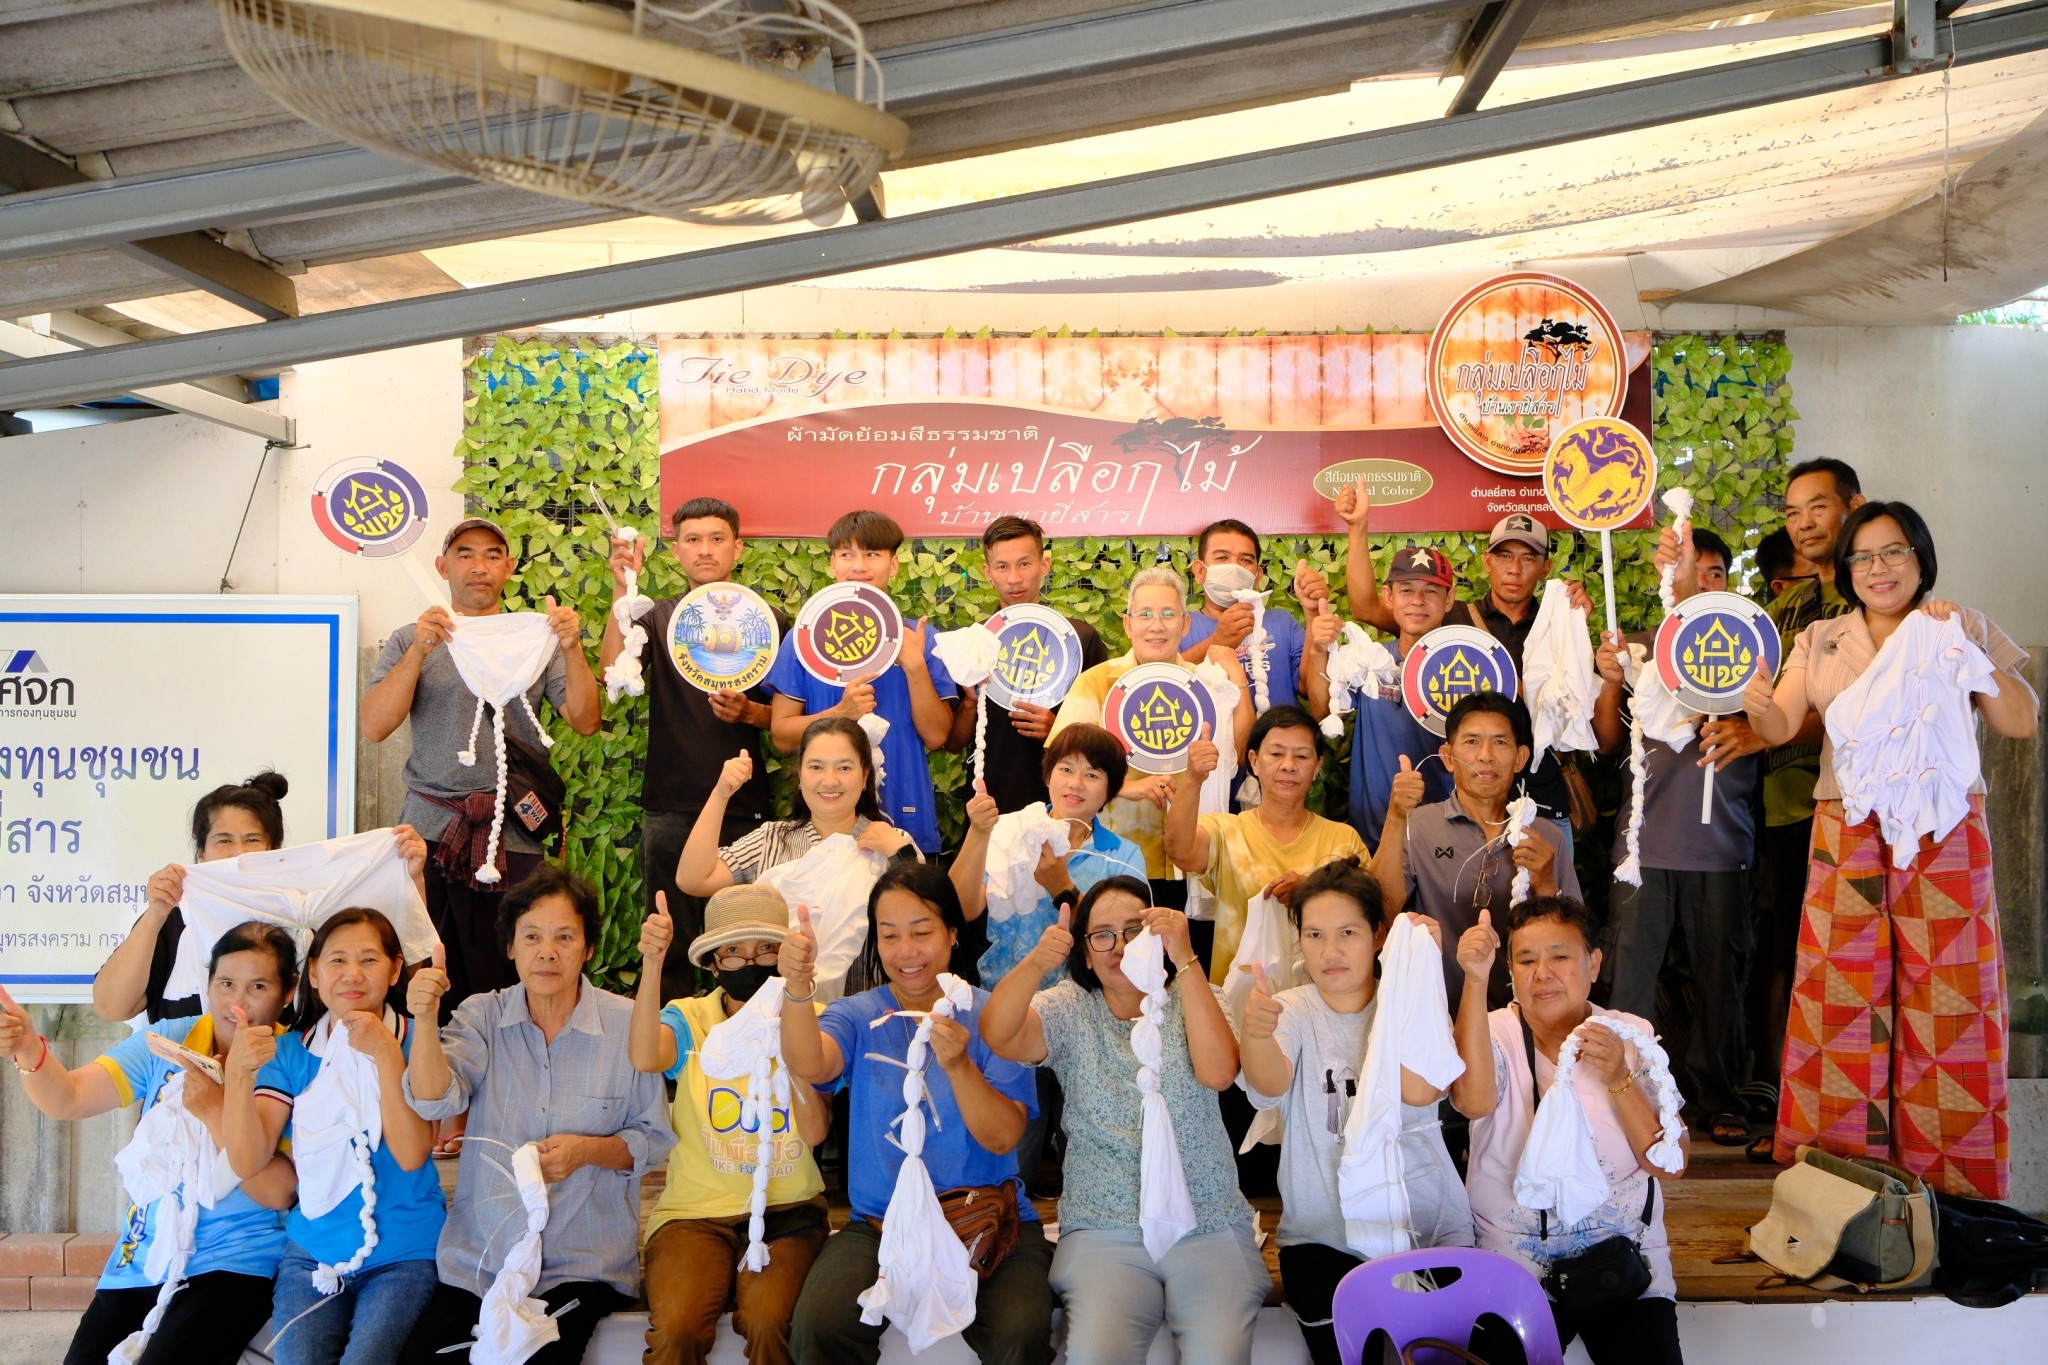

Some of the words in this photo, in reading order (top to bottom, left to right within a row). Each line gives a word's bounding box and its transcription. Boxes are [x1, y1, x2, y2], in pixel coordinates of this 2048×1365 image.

[677, 357, 751, 384] Tie
[768, 357, 867, 398] Dye
[726, 386, 759, 394] Hand
[787, 425, 1039, 442] ผ้ามัดย้อมสีธรรมชาติ
[1382, 486, 1415, 496] Color
[1471, 485, 1516, 498] ตำบลยี่สาร
[679, 652, 768, 690] จังหวัดสมุทรสงคราม
